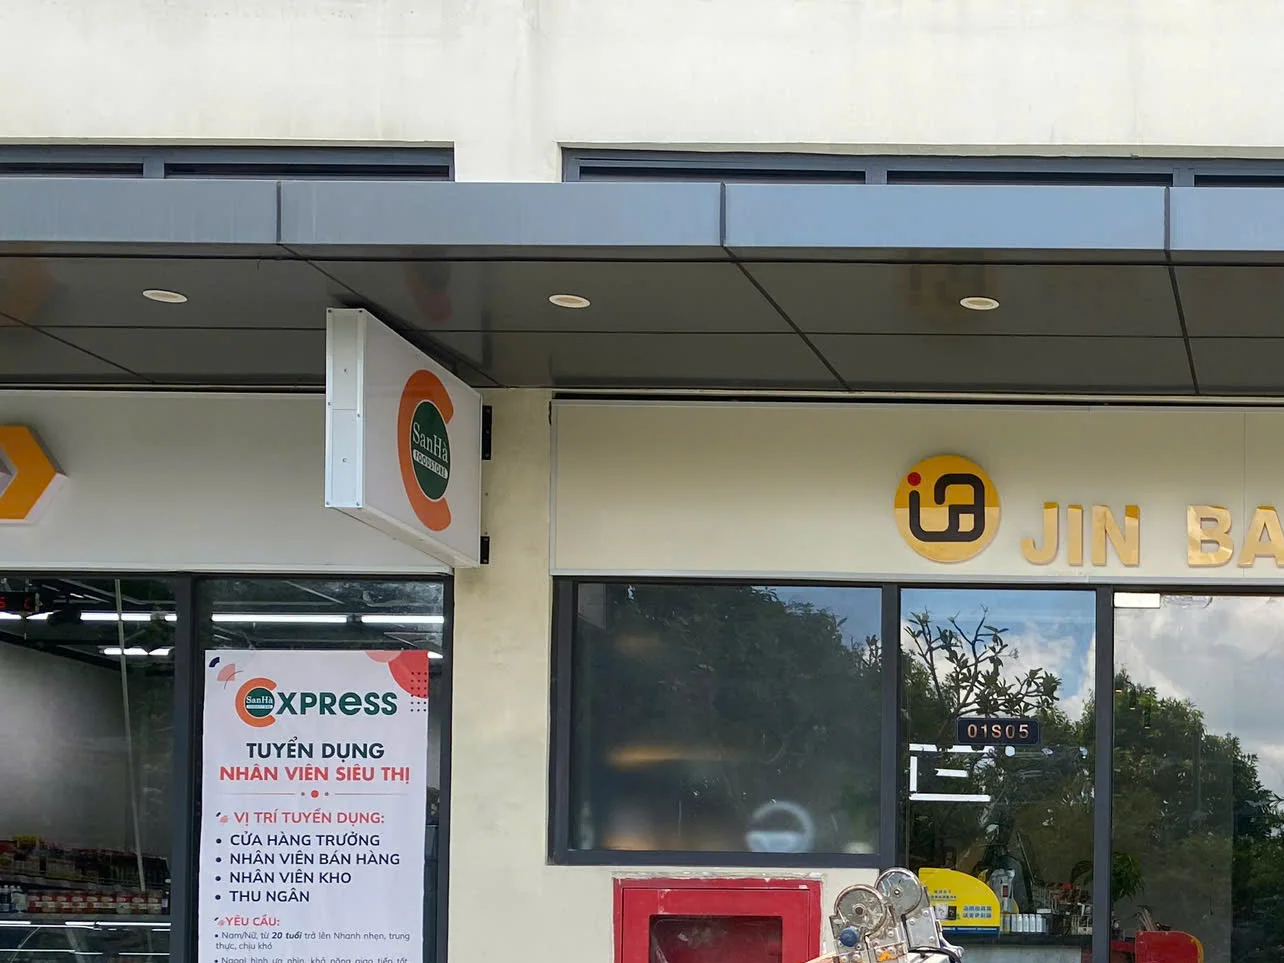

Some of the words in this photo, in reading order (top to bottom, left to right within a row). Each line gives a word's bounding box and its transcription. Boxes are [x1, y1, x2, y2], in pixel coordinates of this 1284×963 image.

[412, 422, 449, 463] SanHà
[413, 450, 449, 479] FOODSTORE
[1020, 502, 1141, 567] JIN
[967, 724, 1029, 739] 01S05
[246, 736, 313, 759] TUYỂN
[322, 742, 385, 763] DỤNG
[219, 764, 278, 781] NHÂN
[285, 764, 329, 781] VIÊN
[336, 764, 375, 781] SIÊU
[381, 767, 410, 785] THỊ
[234, 812, 249, 826] VỊ
[254, 809, 277, 824] TRÍ
[337, 812, 385, 827] DỤNG:
[230, 831, 263, 846] CỬA
[267, 831, 311, 846] HÀNG
[316, 831, 380, 846] TRƯỞNG
[230, 850, 275, 865] NHÂN
[279, 850, 315, 865] VIÊN
[319, 850, 351, 865] BÁN
[356, 850, 400, 865] HÀNG
[229, 869, 275, 884] NHÂN
[279, 869, 315, 884] VIÊN
[319, 871, 352, 884] KHO
[229, 890, 261, 902] THU
[266, 888, 310, 902] NGÂN
[225, 914, 249, 926] YÊU
[272, 931, 283, 940] 20
[334, 931, 361, 940] Nhanh
